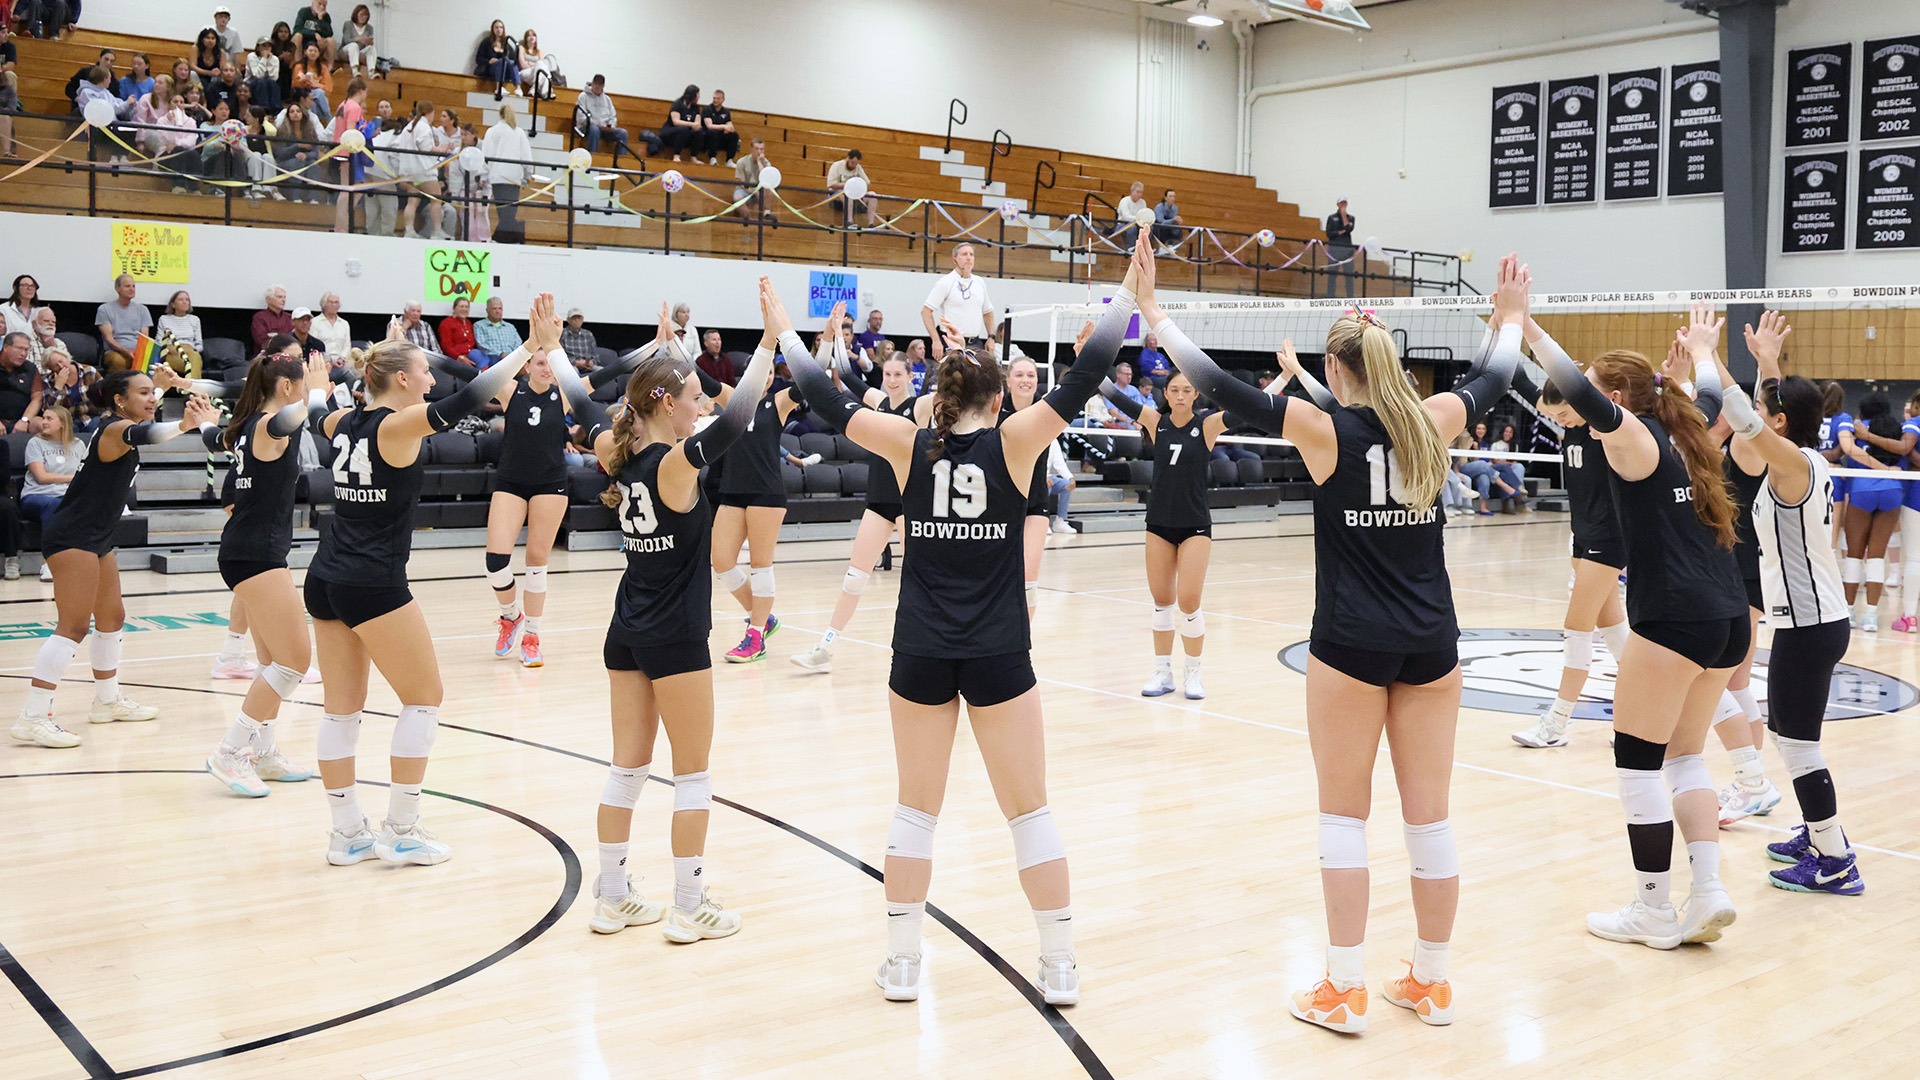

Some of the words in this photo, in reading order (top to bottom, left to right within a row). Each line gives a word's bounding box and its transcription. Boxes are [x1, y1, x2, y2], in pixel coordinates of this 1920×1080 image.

[1871, 82, 1919, 94] BASKETBALL
[1796, 90, 1841, 102] BASKETBALL
[1876, 97, 1912, 108] NESCAC
[1680, 106, 1716, 117] WOMEN'S
[1801, 105, 1834, 115] NESCAC
[1871, 106, 1916, 117] Champions
[1673, 114, 1722, 127] BASKETBALL
[1796, 113, 1838, 124] Champions
[1610, 121, 1657, 133] BASKETBALL
[1878, 119, 1910, 132] 2002
[1550, 127, 1595, 139] BASKETBALL
[1686, 130, 1709, 139] NCAA
[1802, 126, 1831, 139] 2001
[1494, 133, 1536, 144] BASKETBALL
[1623, 137, 1642, 145] NCAA
[1680, 138, 1714, 148] Finalists
[1504, 148, 1524, 156] NCAA
[1561, 142, 1582, 151] NCAA
[1607, 143, 1658, 154] Quarterfinalists
[1554, 150, 1577, 159] Sweet
[1578, 149, 1588, 158] 16
[1494, 155, 1535, 165] Tournament
[1792, 198, 1838, 208] BASKETBALL
[1867, 194, 1914, 203] BASKETBALL
[1797, 212, 1831, 221] NESCAC
[1872, 208, 1907, 217] NESCAC
[1792, 221, 1835, 230] Champions
[1866, 217, 1912, 226] Champions
[1798, 233, 1828, 245] 2007
[1873, 230, 1905, 242] 2009
[115, 249, 159, 276] YOU
[430, 249, 490, 273] GAY
[823, 273, 844, 287] YOU
[439, 274, 481, 303] Day
[811, 285, 856, 300] BETTAH
[1853, 287, 1906, 297] BOWDOIN
[1547, 294, 1588, 303] BOWDOIN
[1591, 293, 1621, 302] POLAR
[1624, 293, 1654, 301] BEARS
[1690, 291, 1737, 300] BOWDOIN
[1740, 290, 1774, 299] POLAR
[1777, 289, 1812, 298] BEARS
[1168, 302, 1187, 310] BEARS
[1310, 300, 1342, 308] BOWDOIN
[1344, 299, 1368, 307] POLAR
[527, 406, 542, 426] 3
[332, 433, 373, 486] 24
[1169, 443, 1183, 466] 7
[1567, 444, 1583, 468] 10
[334, 486, 388, 503] OWDOIN
[932, 459, 988, 519] 19
[1344, 506, 1438, 528] BOWDOIN
[910, 520, 1008, 540] BOWDOIN
